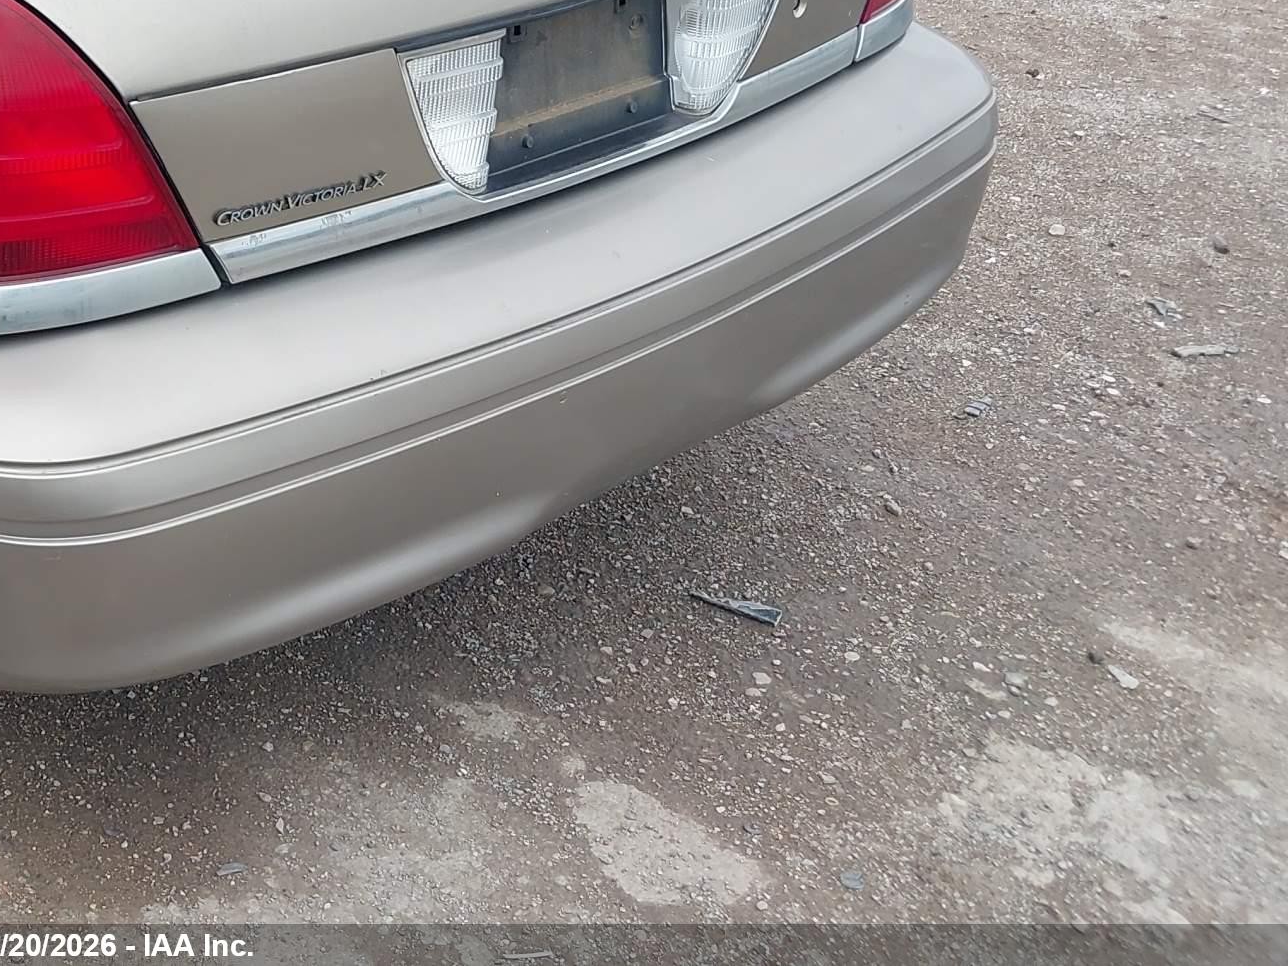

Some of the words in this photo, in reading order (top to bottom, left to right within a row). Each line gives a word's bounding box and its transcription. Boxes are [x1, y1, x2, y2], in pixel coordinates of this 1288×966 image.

[214, 198, 284, 226] CROWN
[285, 182, 358, 210] VICTORIA
[361, 171, 388, 191] LX
